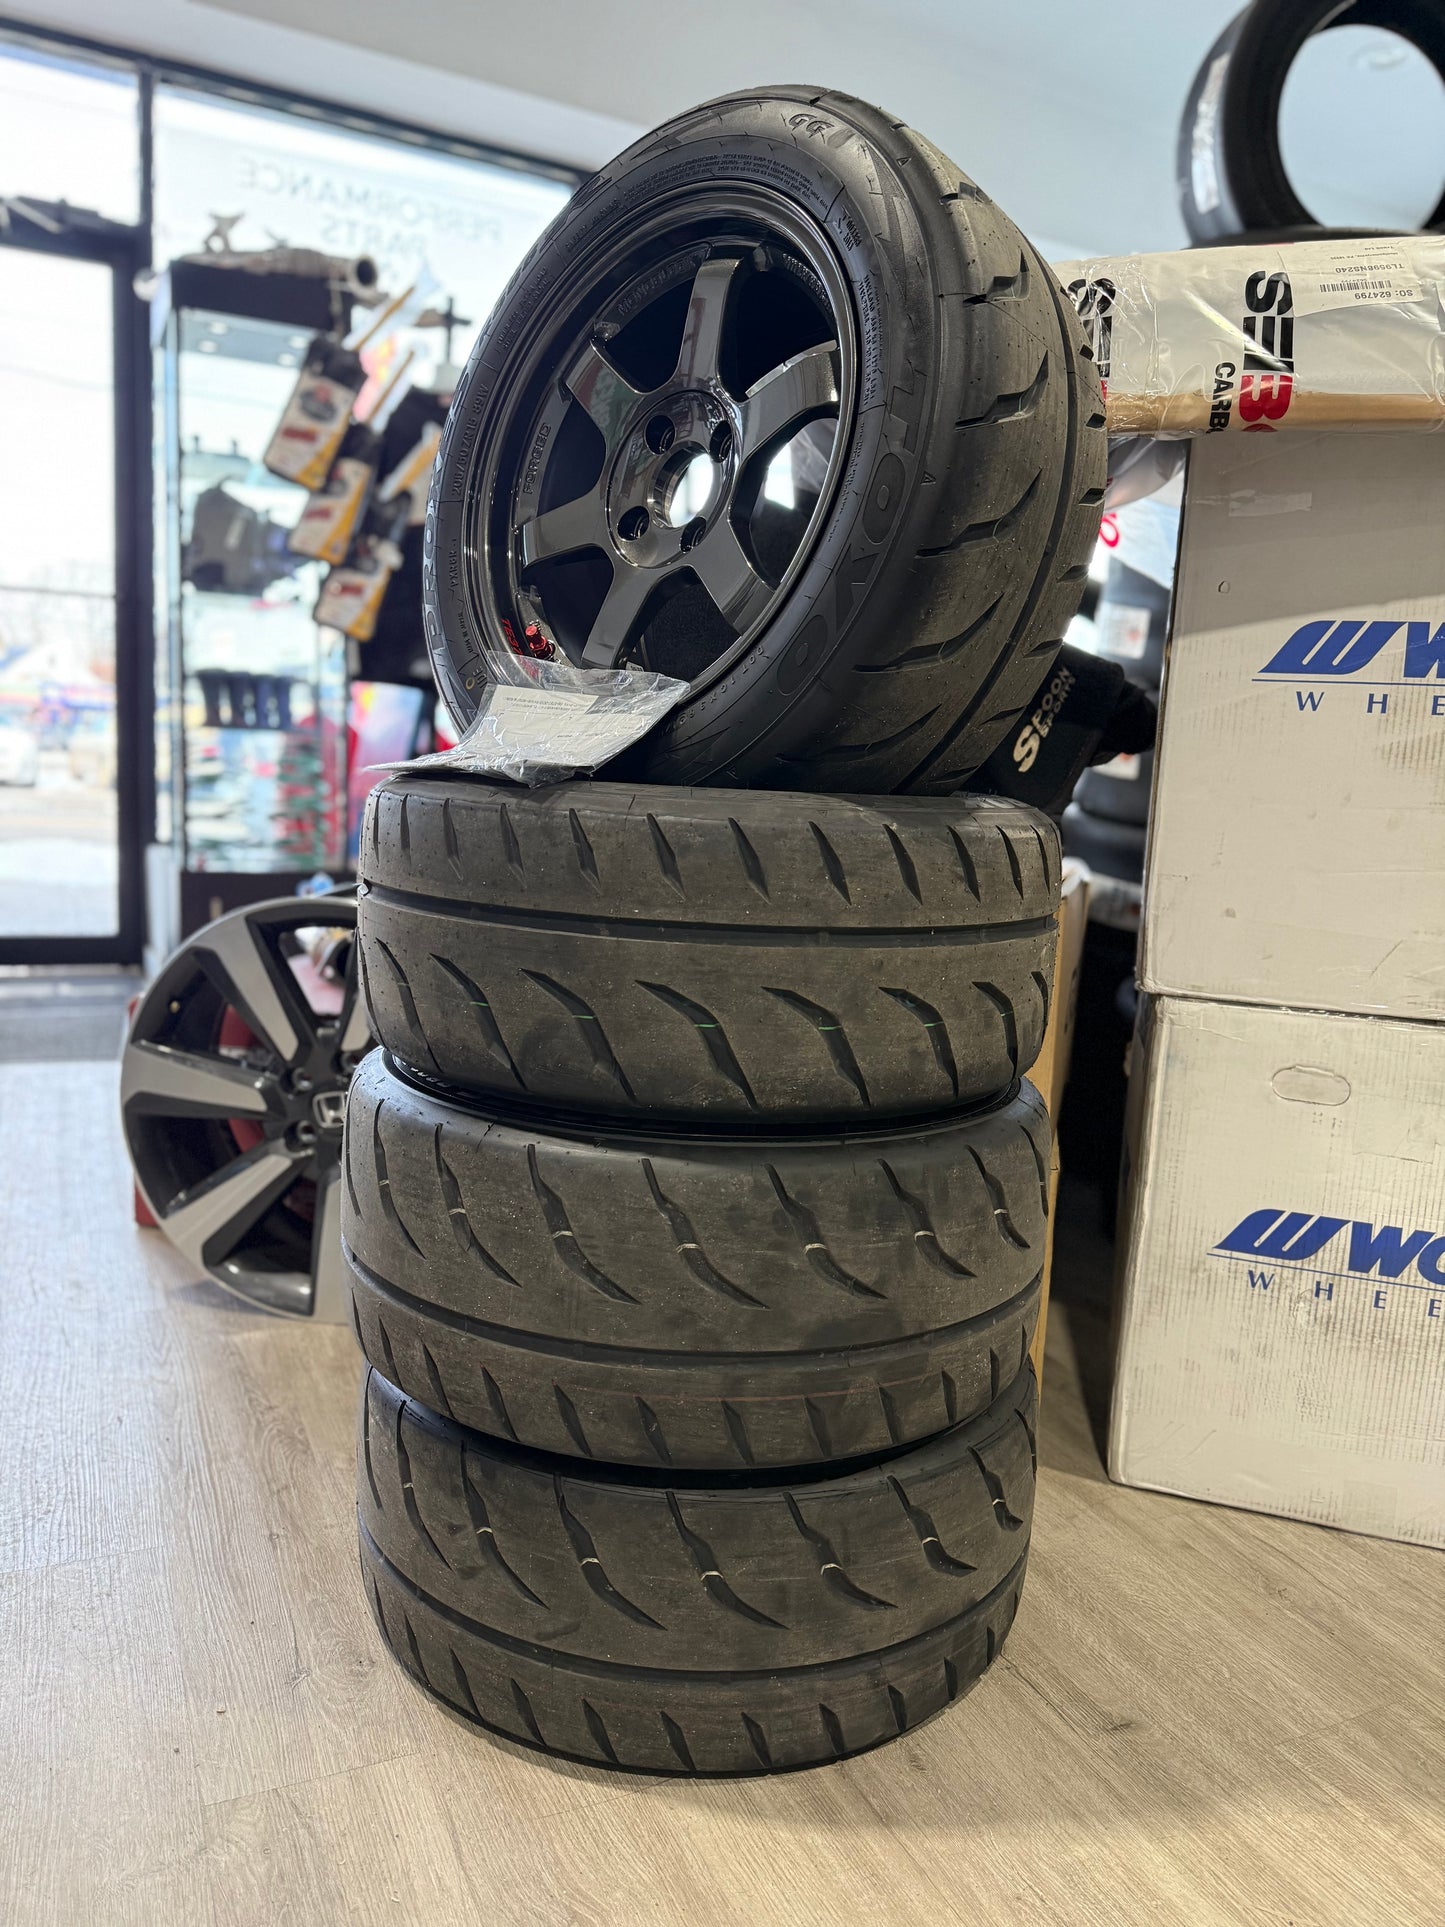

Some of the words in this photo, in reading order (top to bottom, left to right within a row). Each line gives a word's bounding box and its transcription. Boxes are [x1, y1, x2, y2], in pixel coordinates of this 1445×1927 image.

[1354, 291, 1392, 300] 624799
[1395, 289, 1414, 297] SO:
[1239, 270, 1294, 432] SEIB
[1206, 362, 1236, 433] CARB
[523, 422, 552, 495] FORGED
[777, 369, 928, 696] TOYO
[1013, 665, 1072, 773] SPOON
